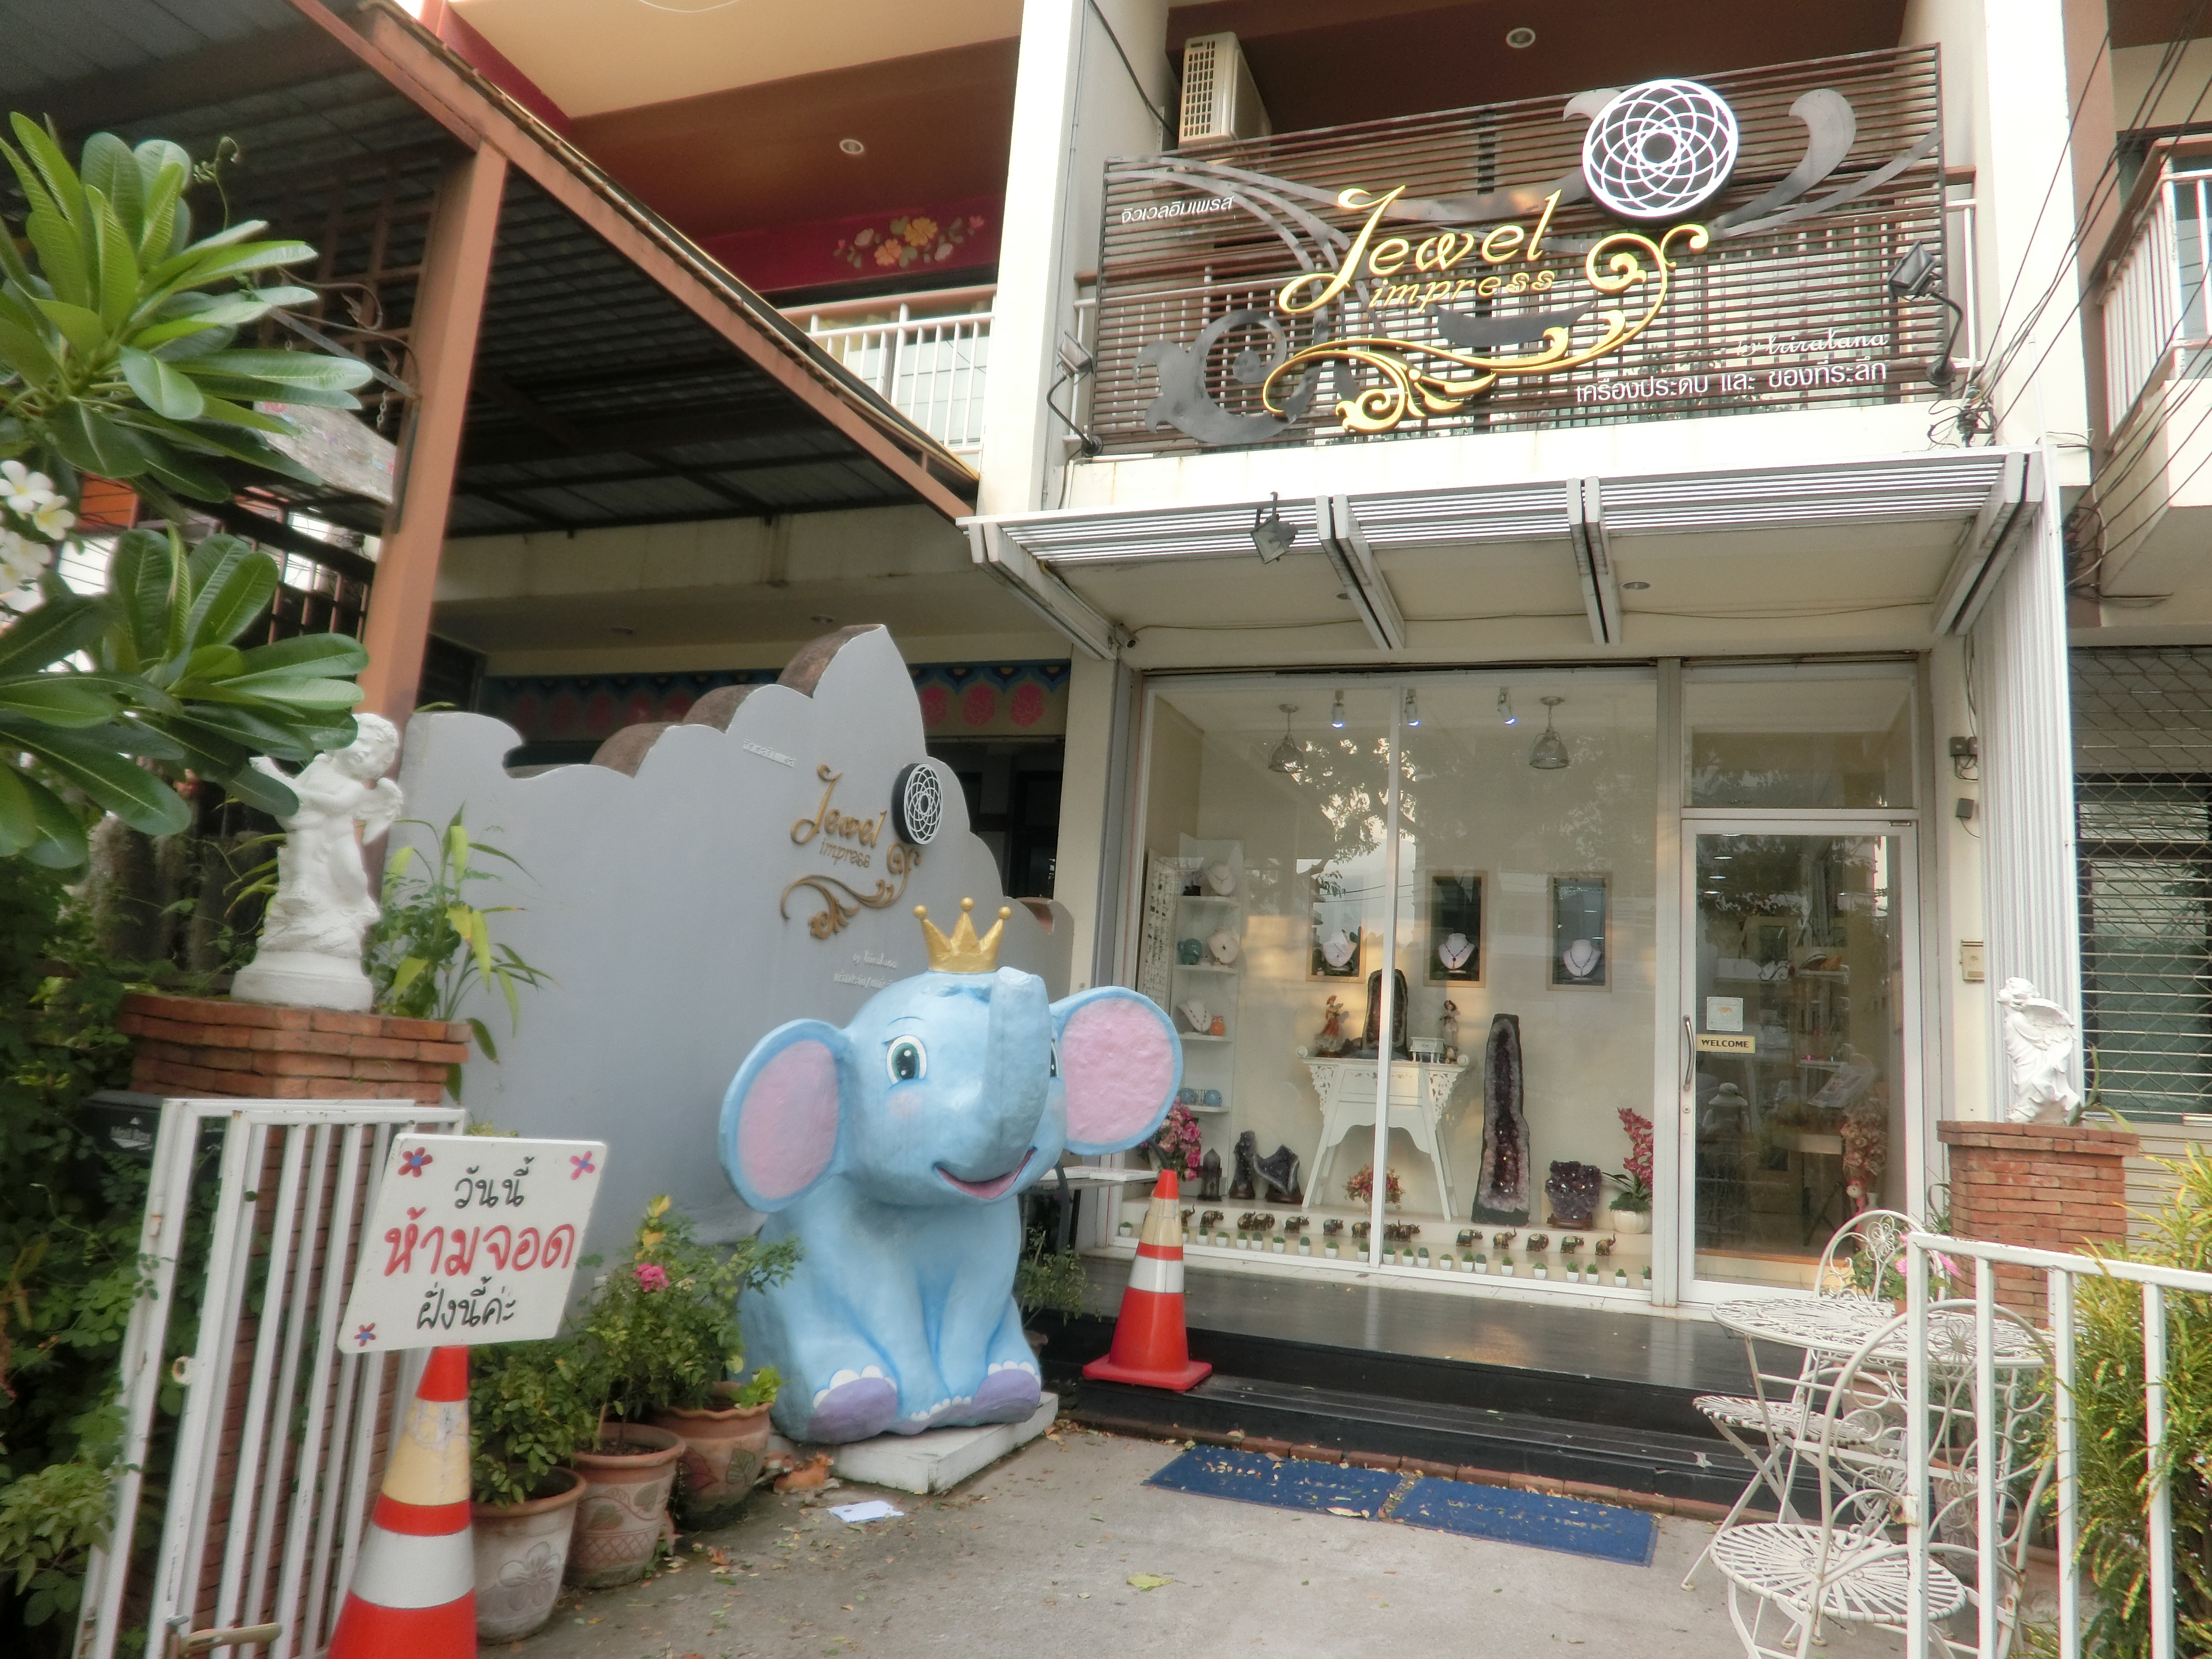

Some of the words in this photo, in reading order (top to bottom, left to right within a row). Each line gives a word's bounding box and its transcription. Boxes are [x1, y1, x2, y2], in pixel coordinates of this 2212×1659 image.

[1278, 185, 1562, 313] Jewel
[1369, 270, 1556, 313] impress
[1720, 372, 1756, 392] และ
[791, 765, 887, 849] Jewel
[819, 837, 870, 867] impress
[1701, 1039, 1749, 1048] WELCOME
[454, 1156, 535, 1209] วันนี้
[384, 1206, 575, 1276] ห้ามจอด
[416, 1276, 516, 1330] ฝั่งนี้ค่ะ
